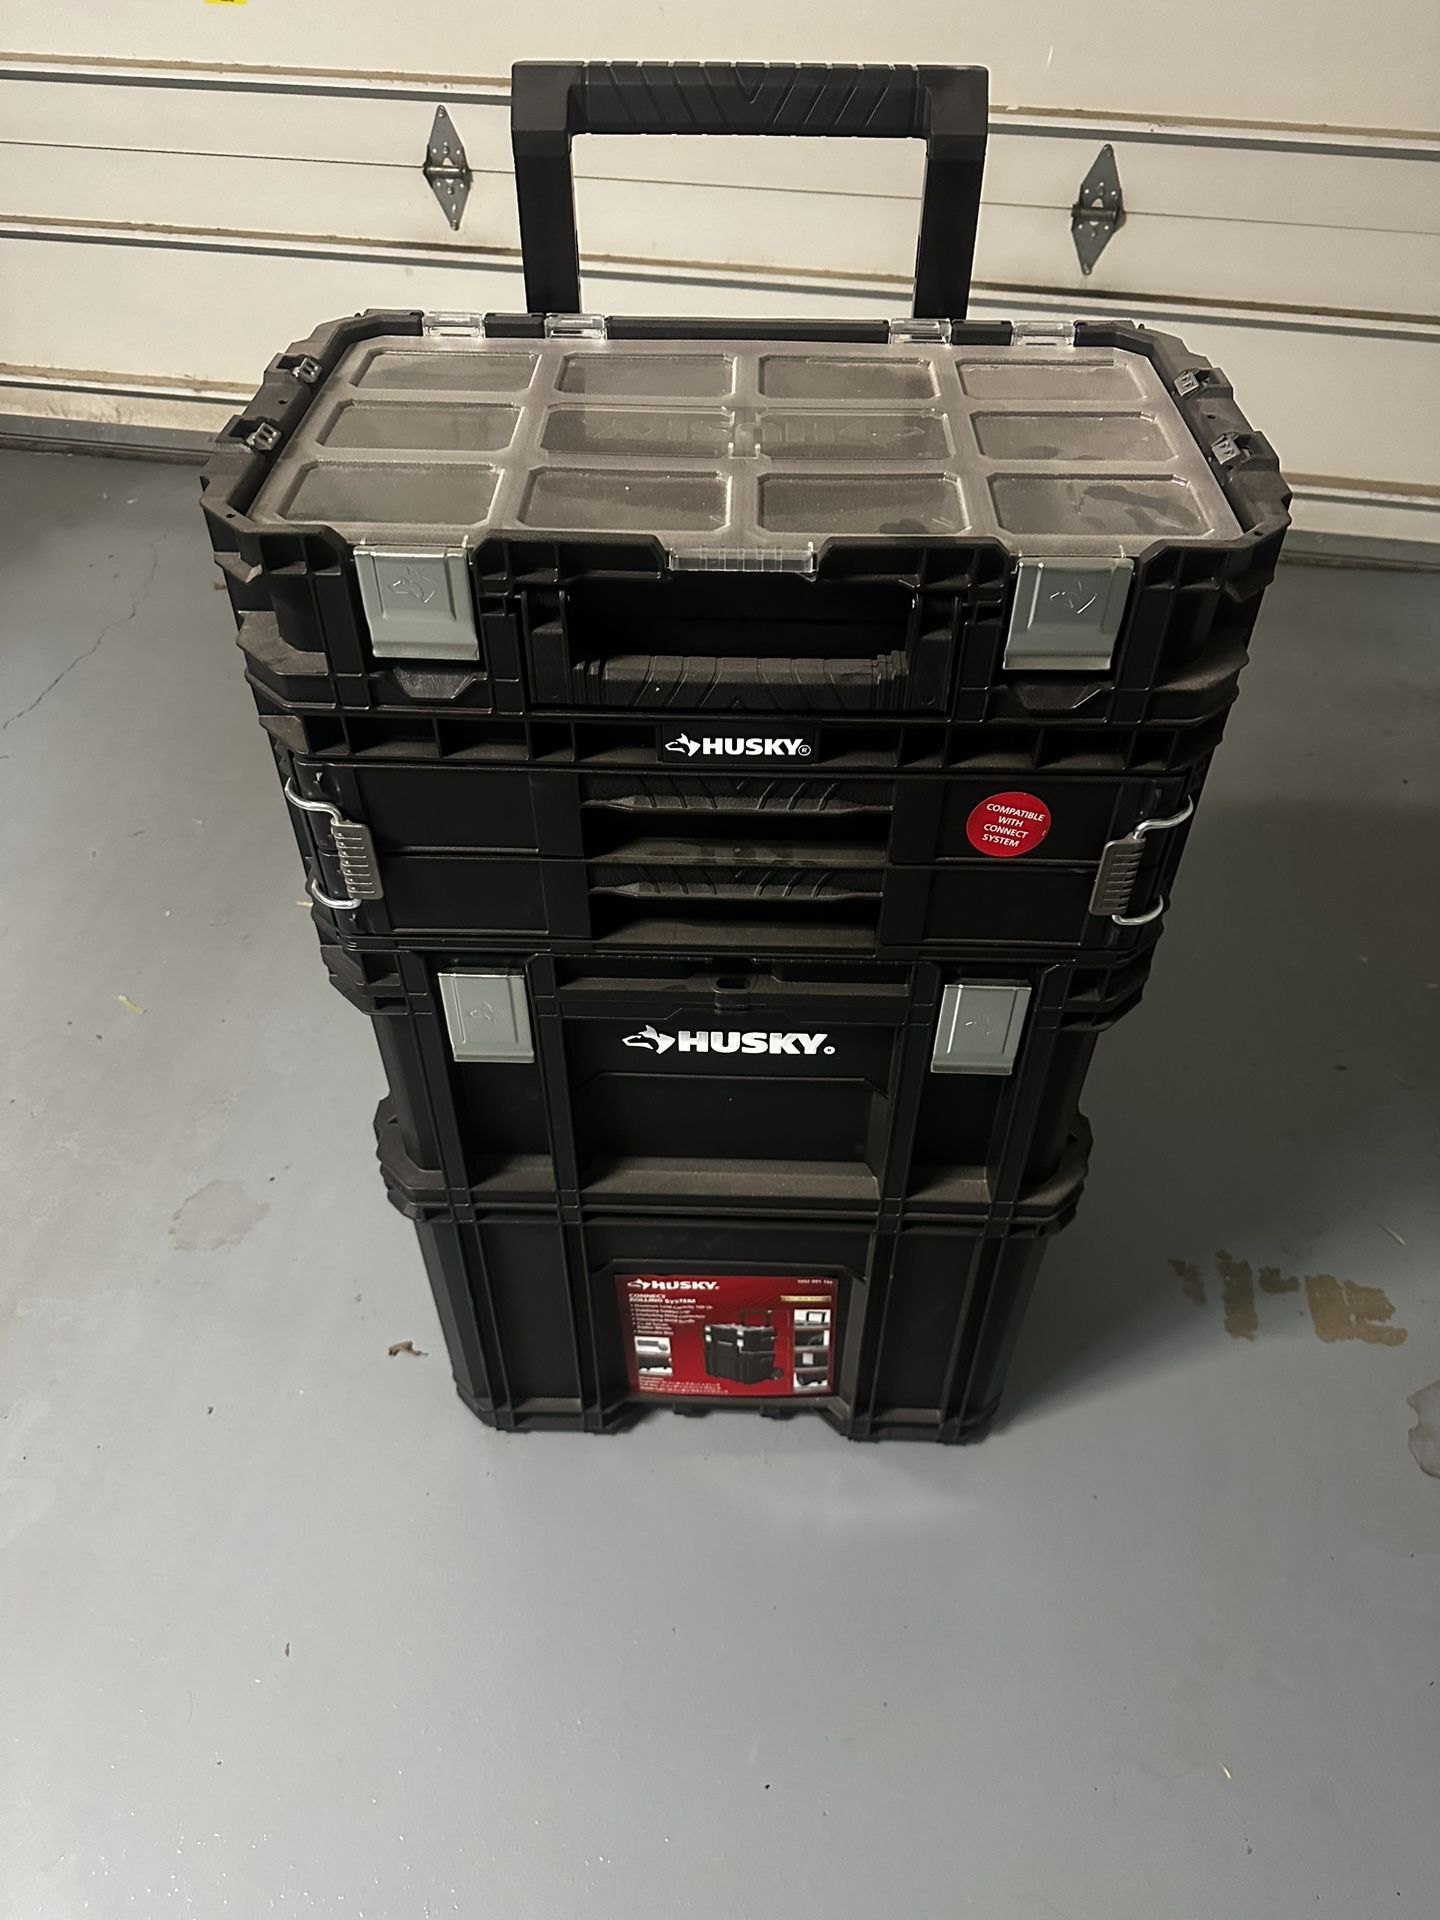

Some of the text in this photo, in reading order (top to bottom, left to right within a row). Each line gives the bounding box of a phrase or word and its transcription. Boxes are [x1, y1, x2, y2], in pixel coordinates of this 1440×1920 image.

[986, 803, 1046, 822] COMPATIBLE
[998, 815, 1024, 828] WITH
[983, 823, 1029, 839] CONNECT
[982, 833, 1020, 848] SYSTEM
